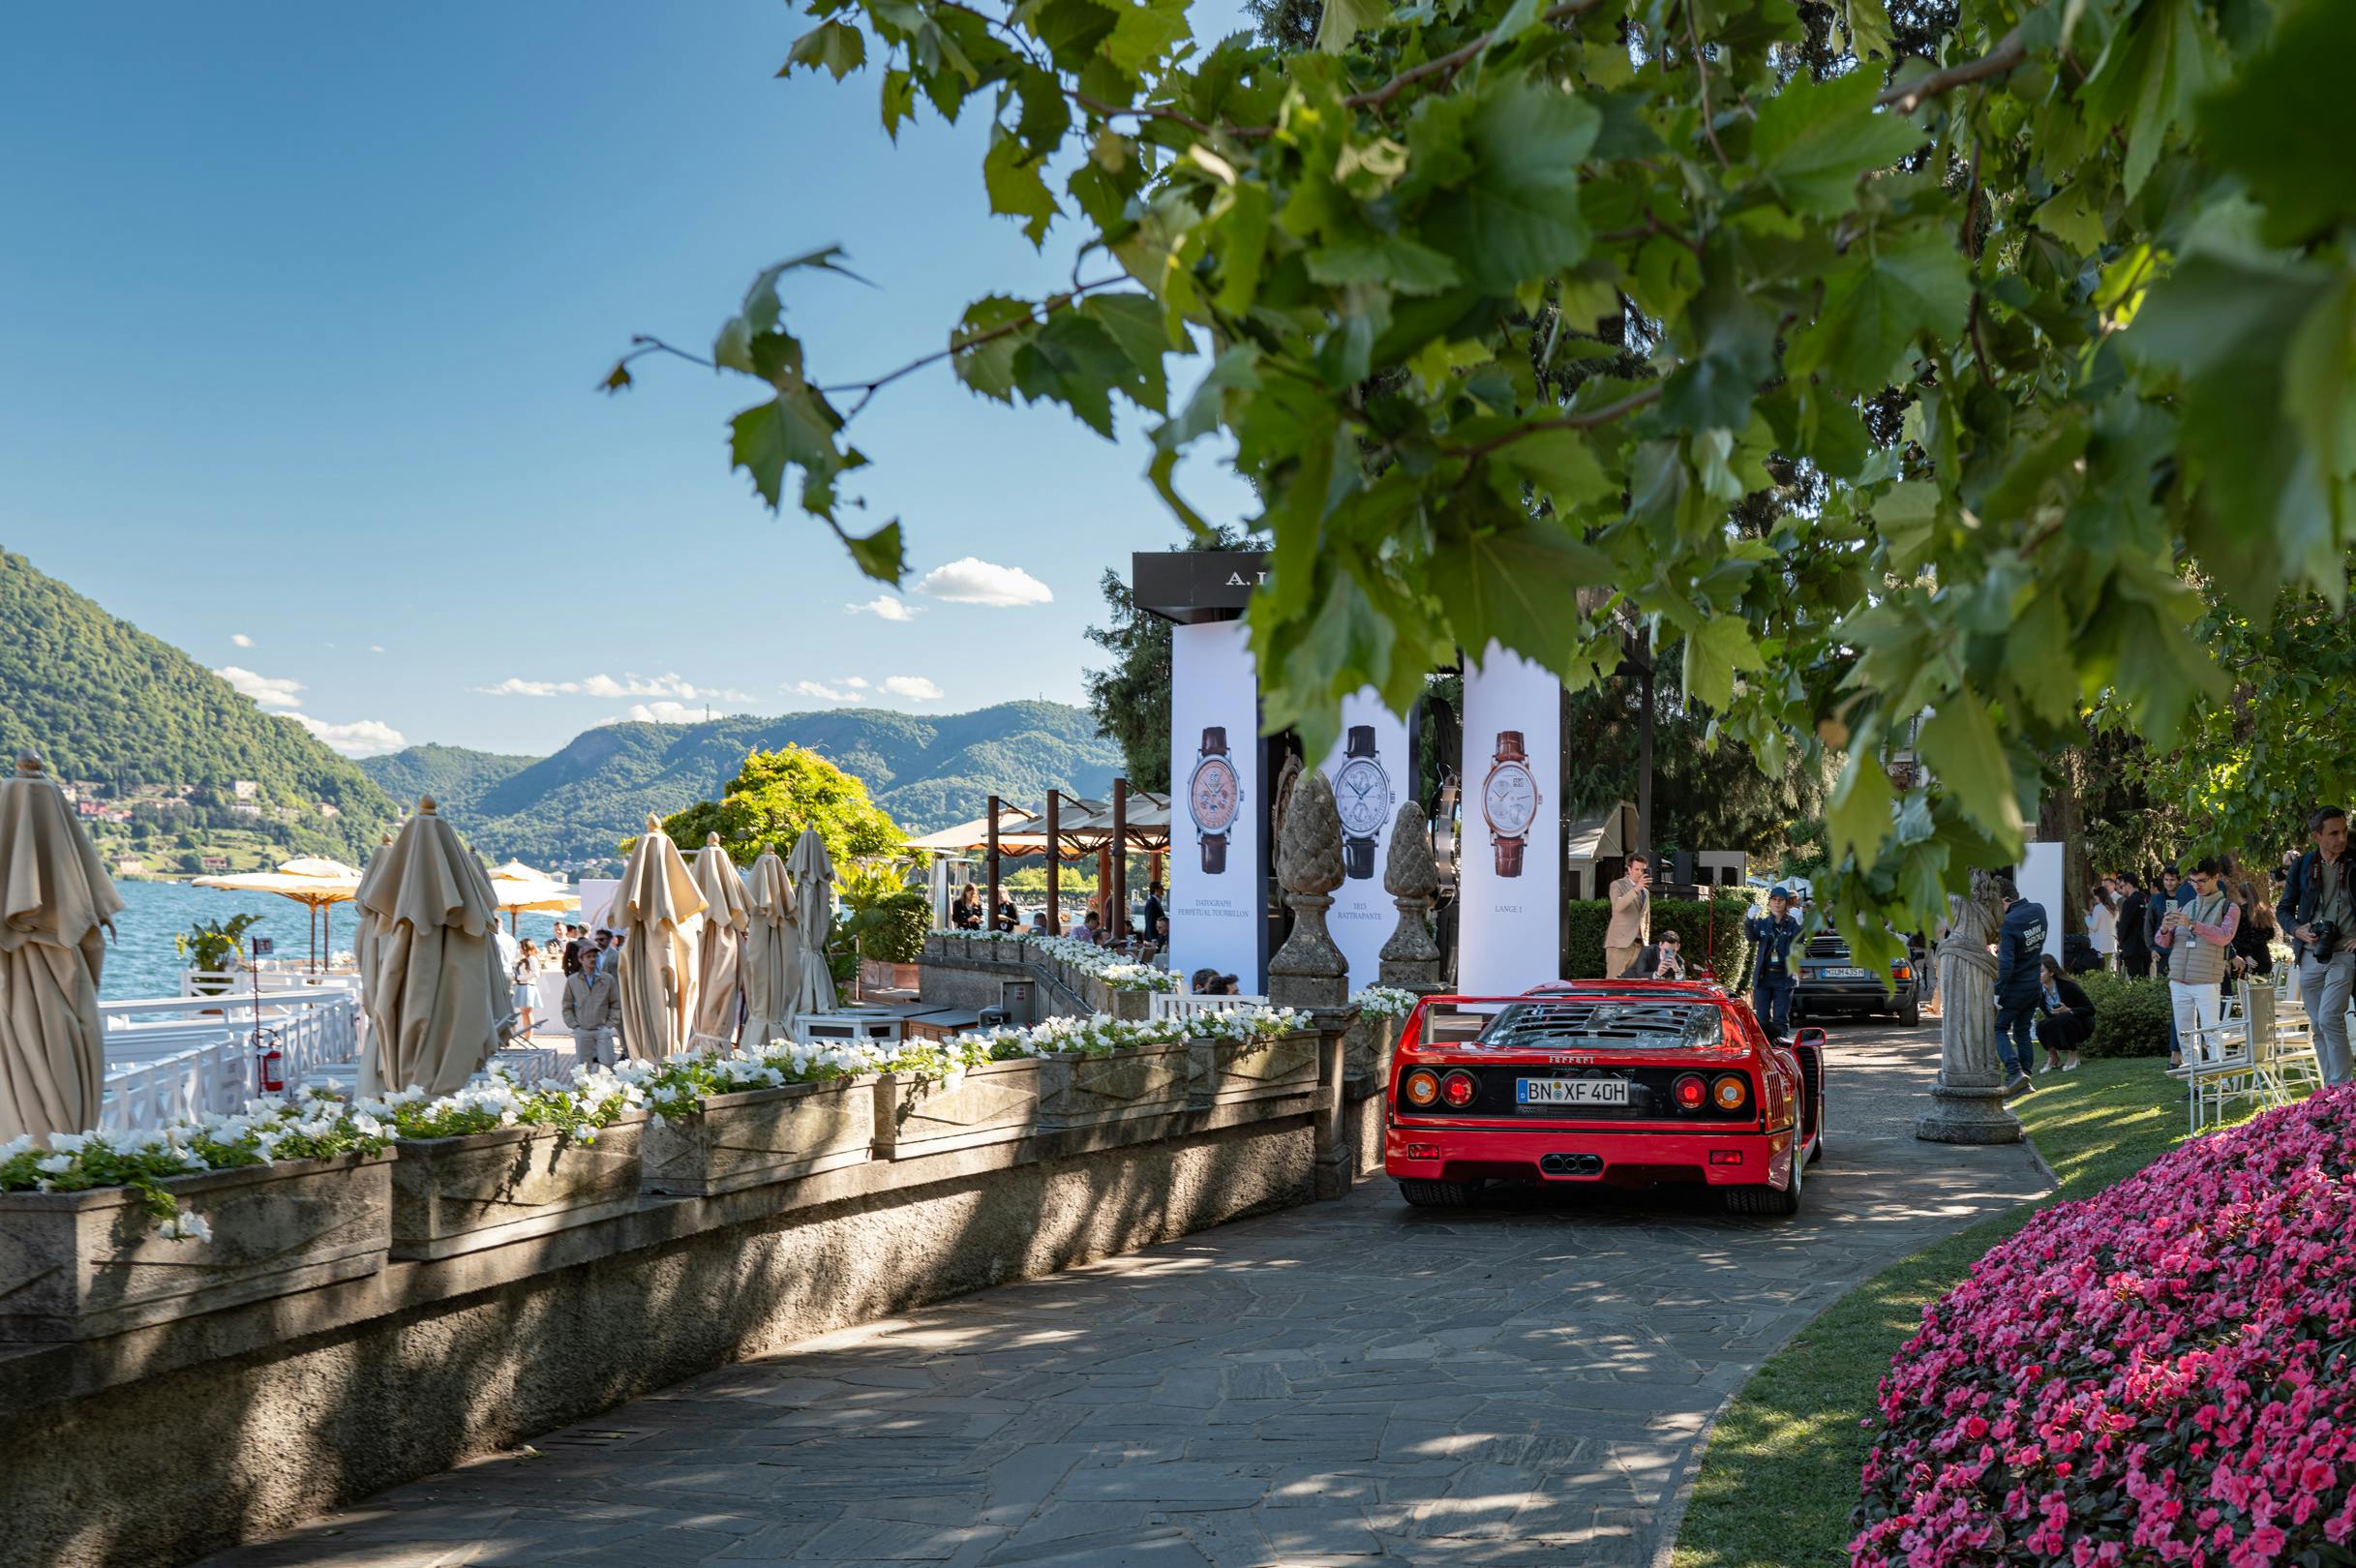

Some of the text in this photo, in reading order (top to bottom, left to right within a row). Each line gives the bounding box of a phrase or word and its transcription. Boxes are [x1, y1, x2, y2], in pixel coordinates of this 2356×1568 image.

[1177, 908, 1249, 918] PERPETUAL TOURBILLON
[1495, 905, 1518, 914] LANGE
[1338, 912, 1382, 920] RATTRAPANTE
[2023, 923, 2041, 939] BMW
[1549, 1055, 1595, 1064] Ferrari
[1528, 1083, 1552, 1101] BN
[1564, 1083, 1586, 1101] XF
[1591, 1083, 1625, 1101] 40H
